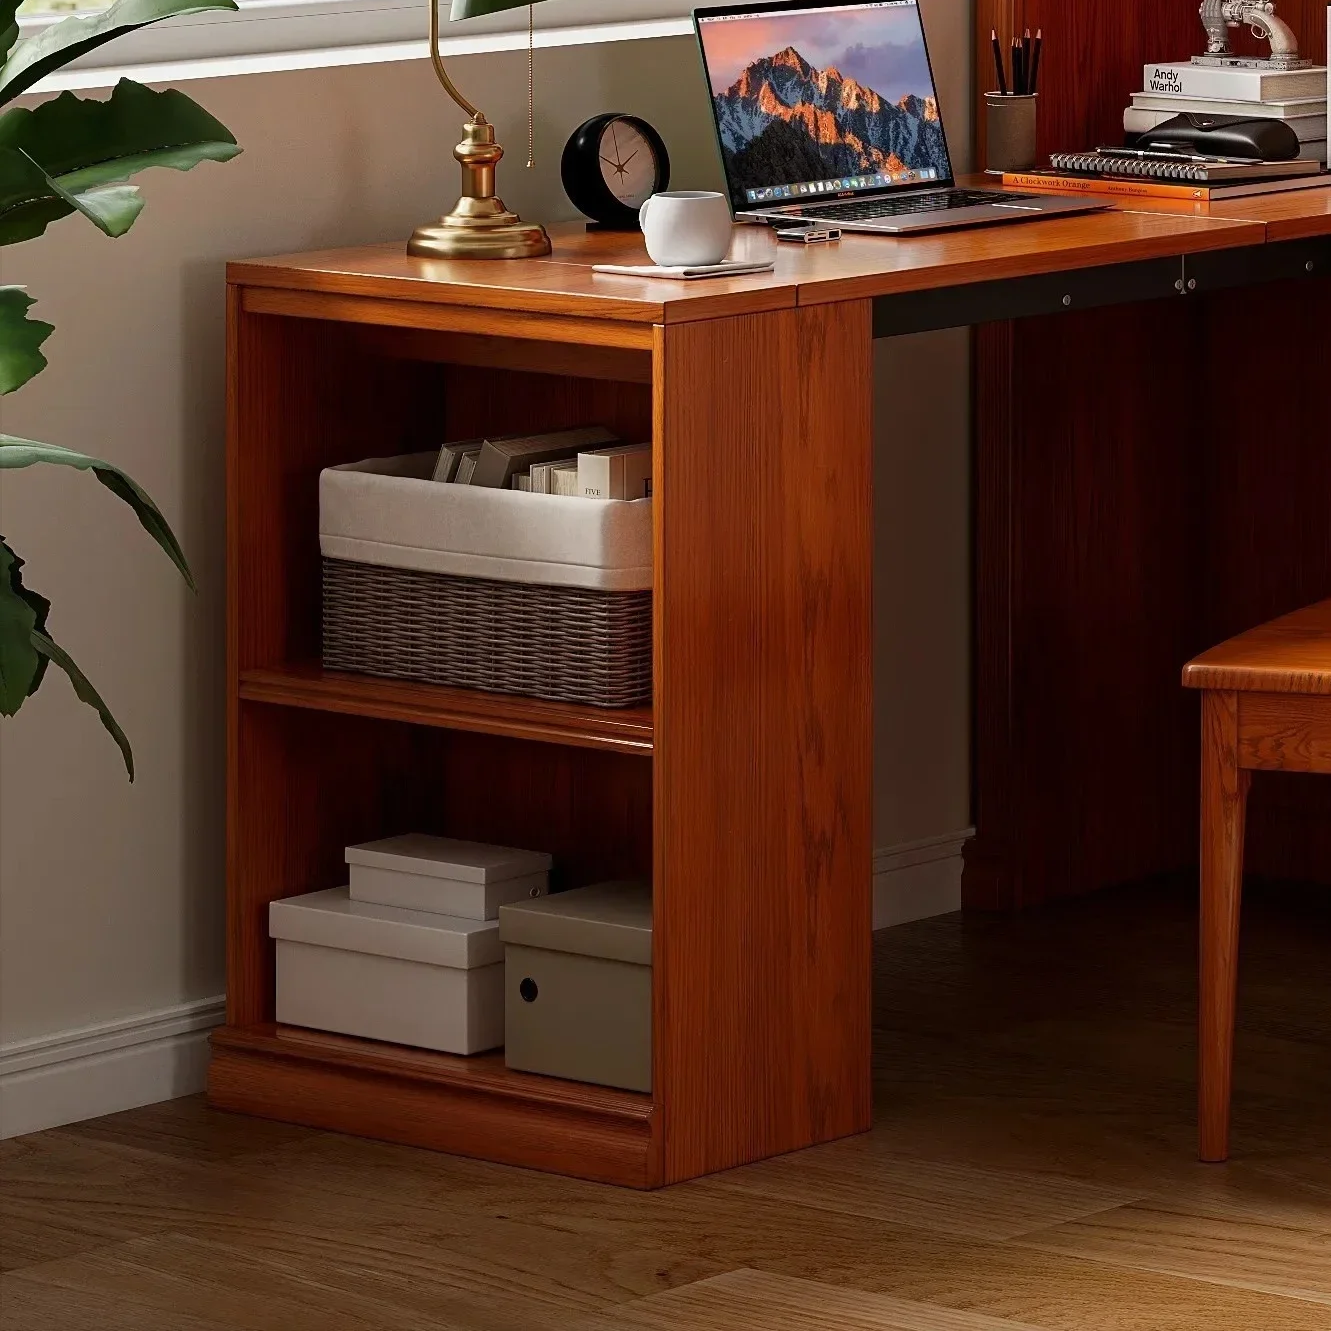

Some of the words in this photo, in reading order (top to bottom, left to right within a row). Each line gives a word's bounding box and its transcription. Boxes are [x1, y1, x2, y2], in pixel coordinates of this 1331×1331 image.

[1153, 68, 1179, 83] Andy
[1149, 79, 1182, 93] Warhol
[1012, 176, 1019, 184] A
[1020, 176, 1061, 187] Clockwork
[1062, 179, 1091, 189] Orange
[585, 487, 601, 496] FIVE
